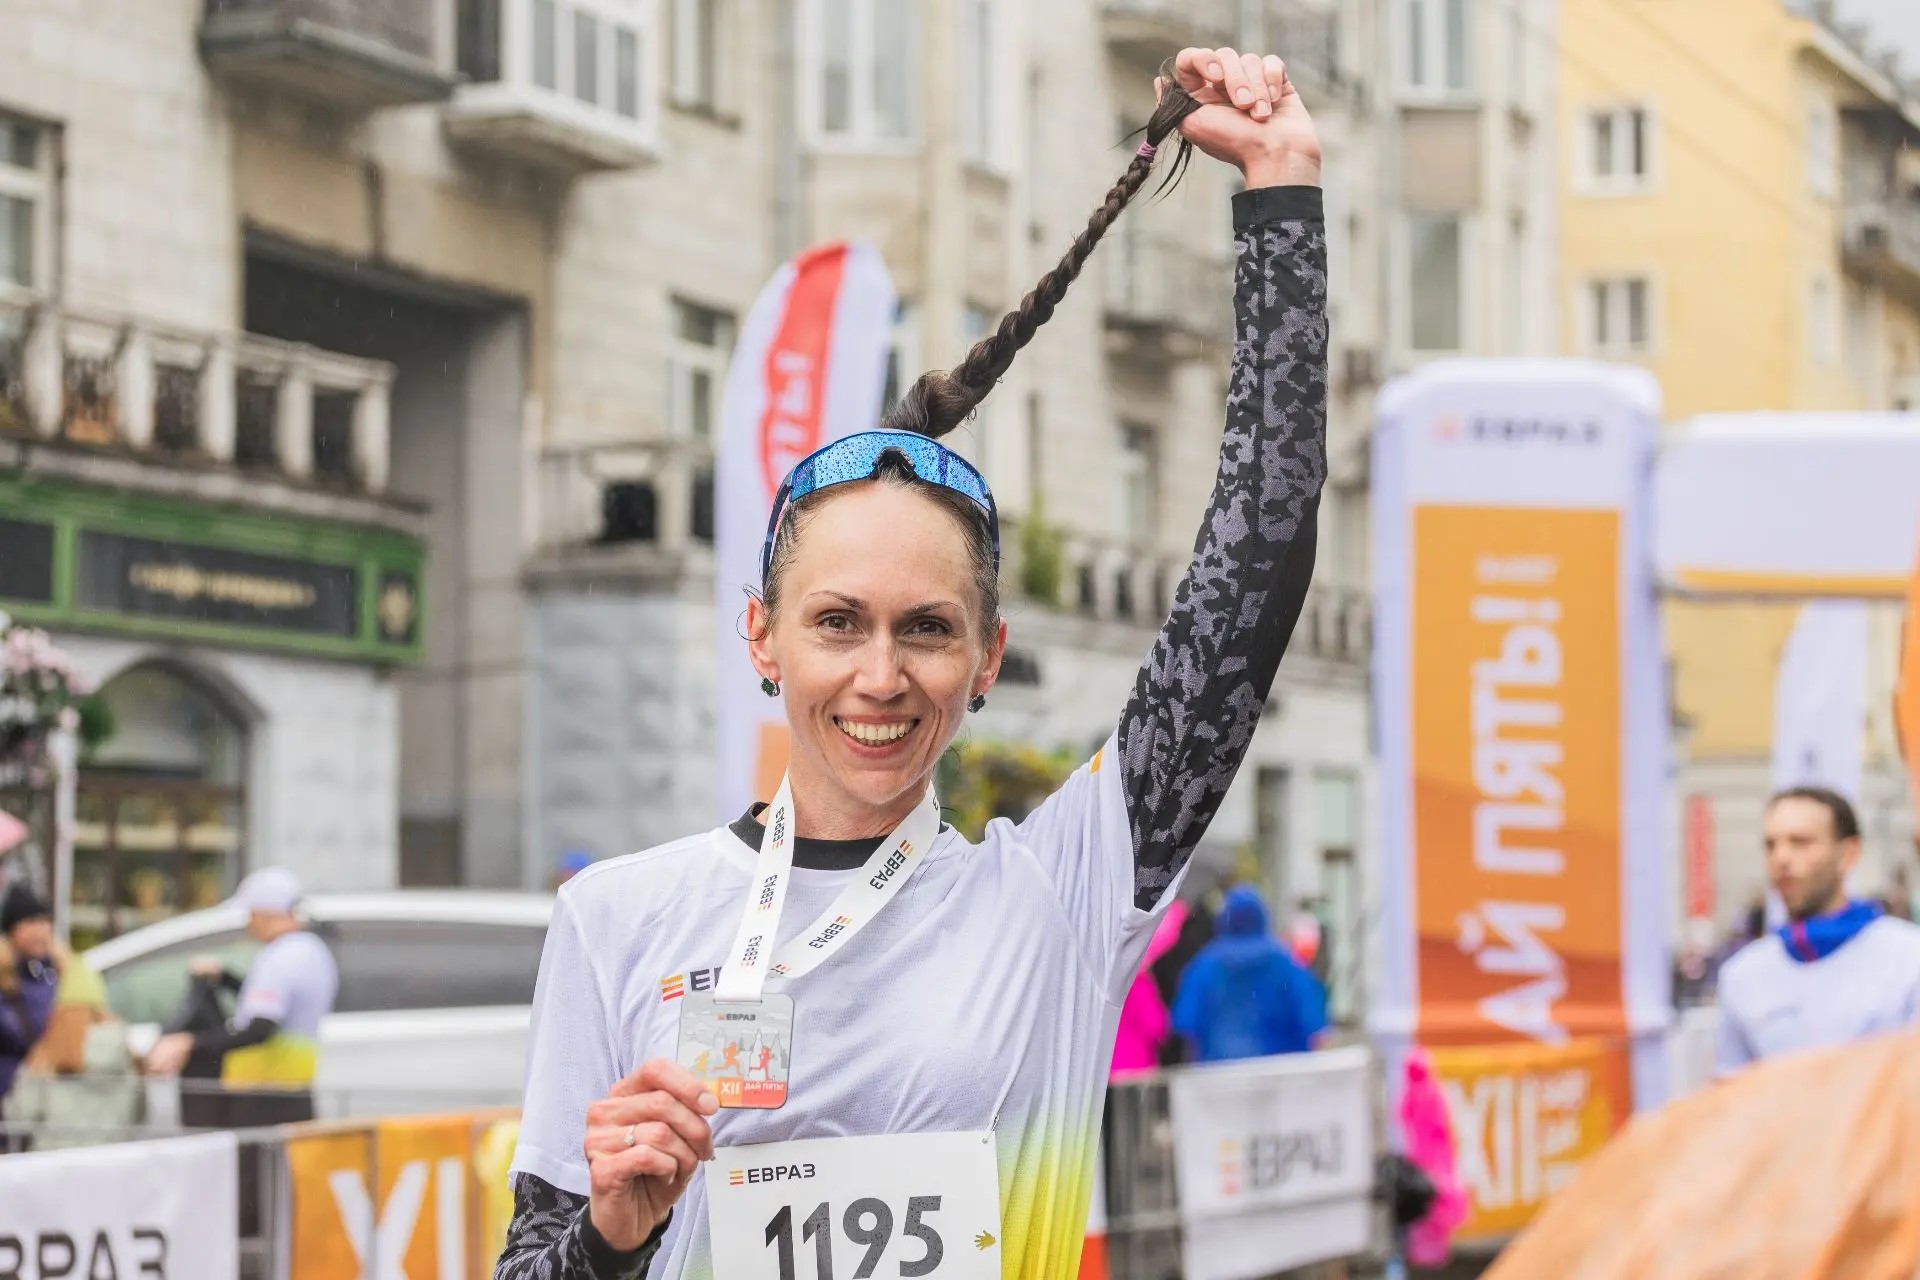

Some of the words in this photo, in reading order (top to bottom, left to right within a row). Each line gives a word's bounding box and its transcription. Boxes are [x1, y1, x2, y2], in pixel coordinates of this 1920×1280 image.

[1472, 595, 1564, 875] ПЯТЬ!
[772, 806, 785, 843] ЕВРАЗ
[869, 849, 907, 890] ЕВРАЗ
[760, 874, 778, 905] ЕВРАЗ
[808, 923, 845, 949] ЕВРАЗ
[726, 1013, 756, 1021] ЕВРАЗ
[720, 1081, 741, 1095] XII
[747, 1163, 816, 1184] ЕВРАЗ
[764, 1195, 944, 1280] 1195
